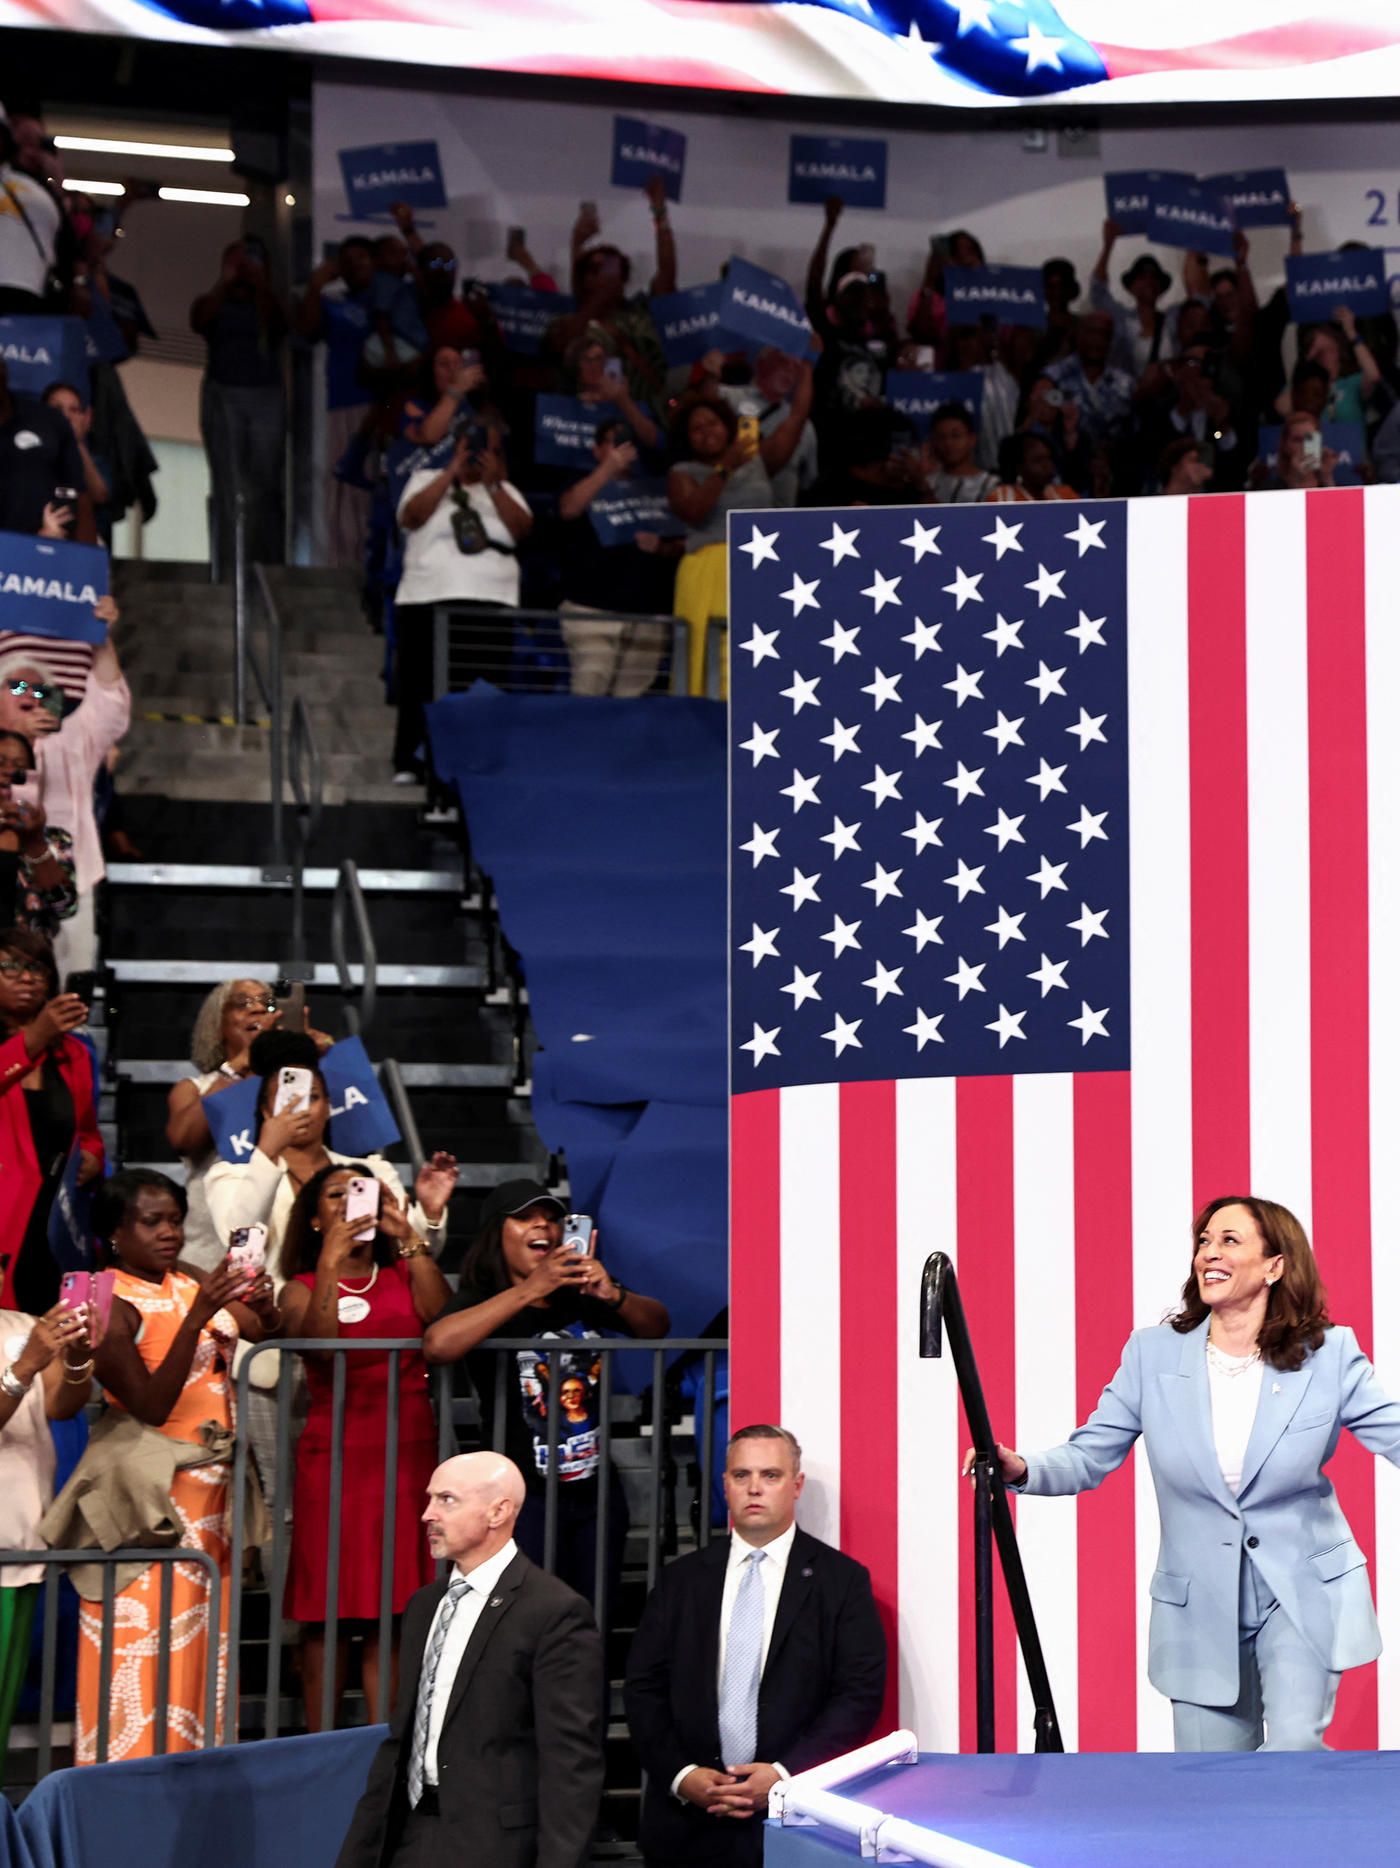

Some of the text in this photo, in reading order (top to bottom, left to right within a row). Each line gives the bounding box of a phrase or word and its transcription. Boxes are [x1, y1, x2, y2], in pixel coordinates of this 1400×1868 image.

[352, 166, 435, 192] KAMALA
[795, 161, 876, 182] KAMALA
[1223, 189, 1284, 207] MALA
[1154, 203, 1234, 231] KAMALA
[953, 286, 1036, 305] KAMALA
[1295, 274, 1378, 297] KAMALA
[664, 311, 720, 340] KAMA
[893, 398, 976, 414] KAMA
[230, 1085, 369, 1156] KLA
